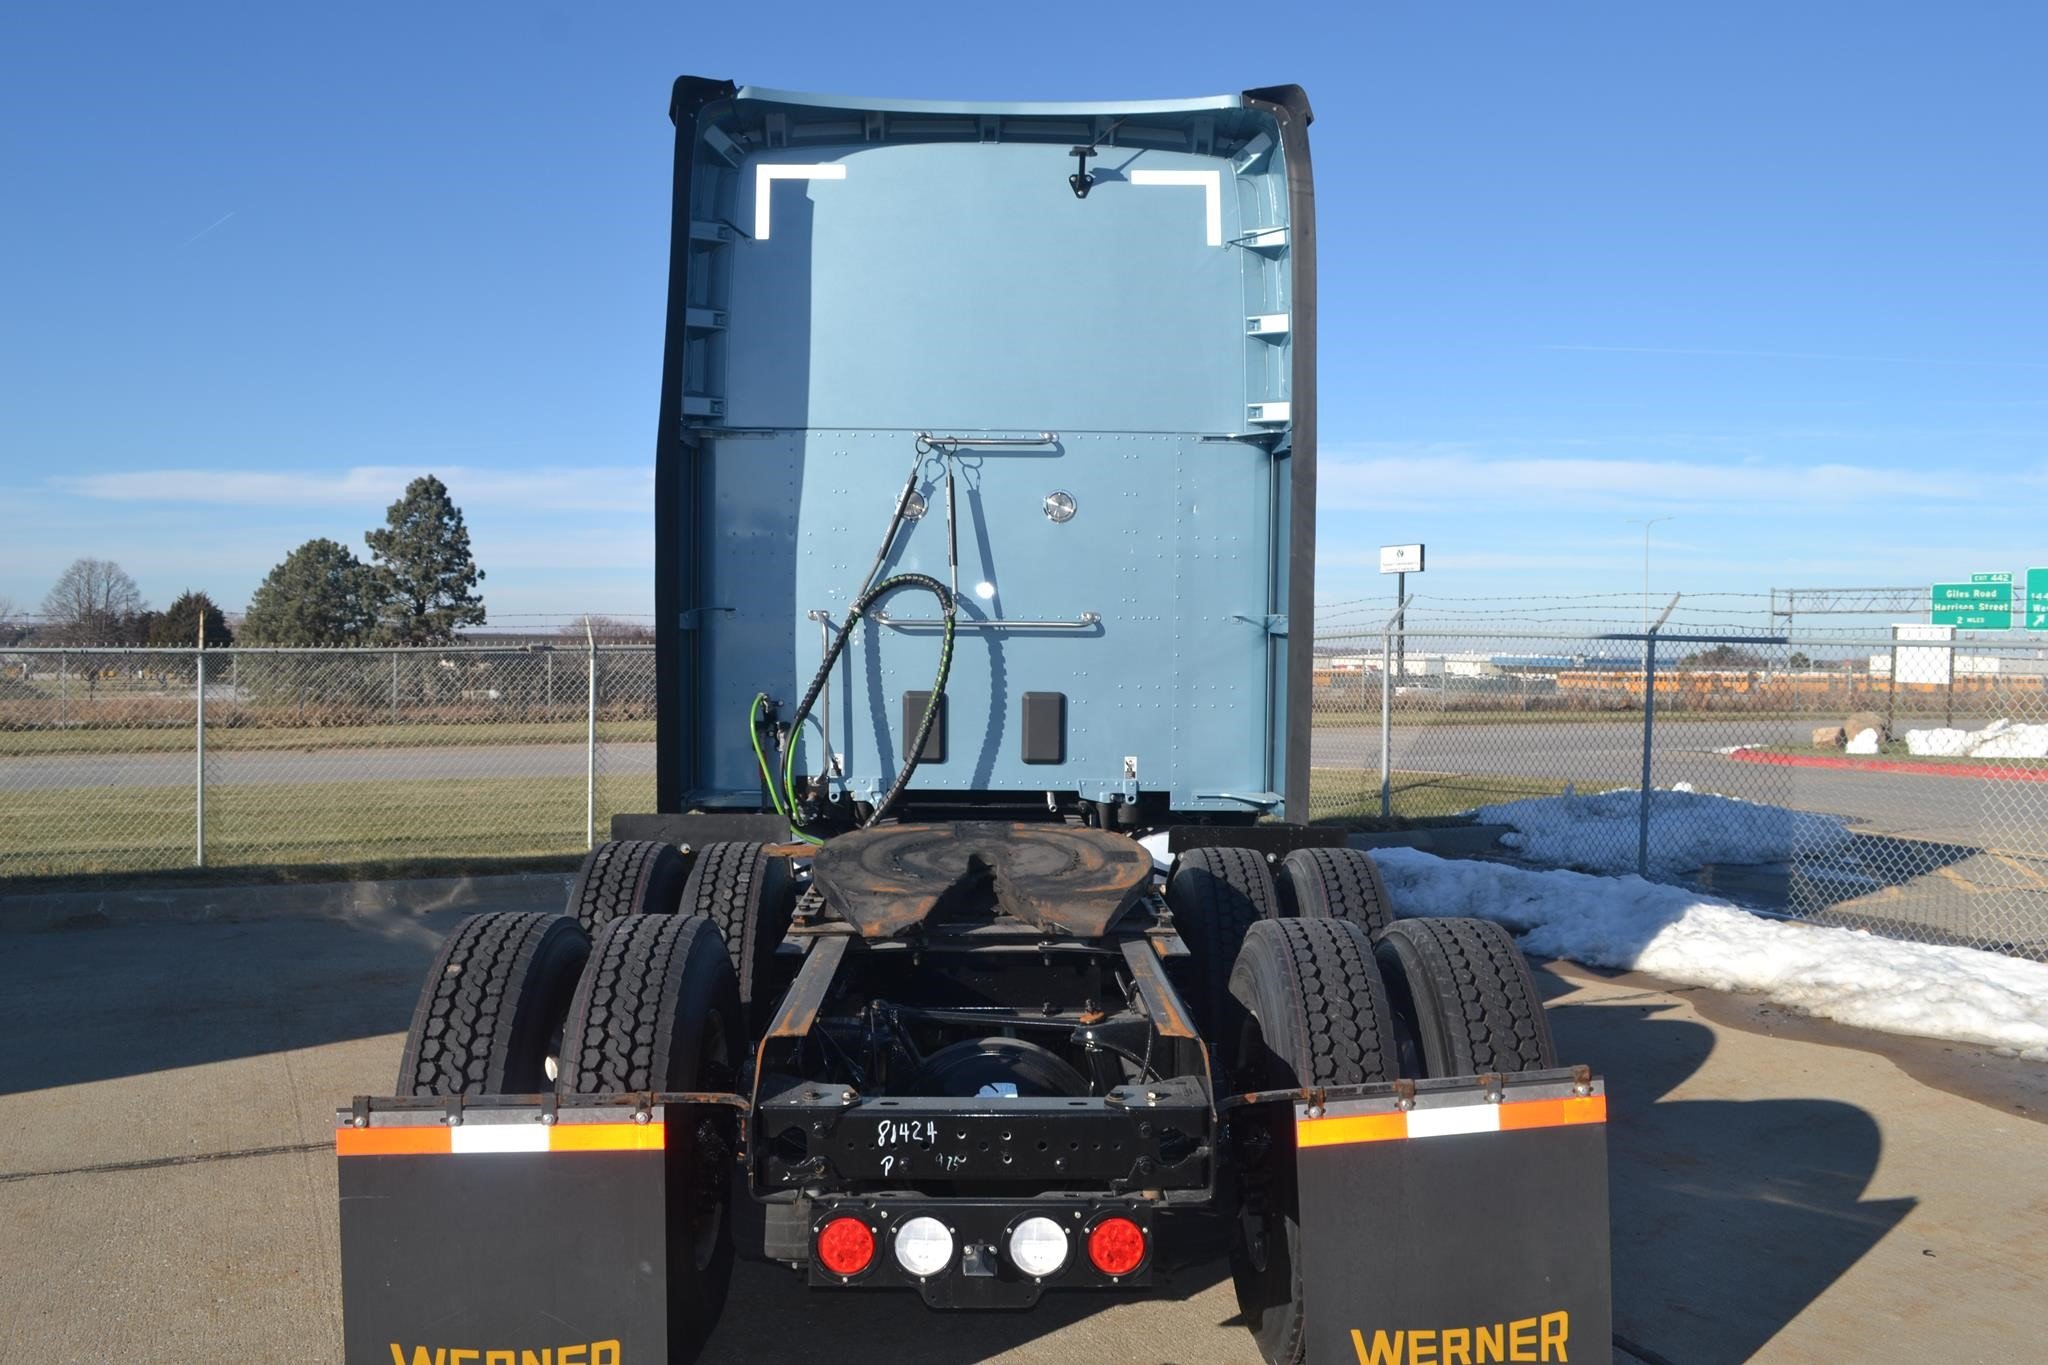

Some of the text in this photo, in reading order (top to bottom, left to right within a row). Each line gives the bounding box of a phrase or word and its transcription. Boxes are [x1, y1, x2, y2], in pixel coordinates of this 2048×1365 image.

[1946, 589, 1997, 598] Giles Road
[1934, 602, 2009, 611] Harrison Street
[1956, 616, 1963, 624] 2
[1350, 1311, 1568, 1365] WERNER
